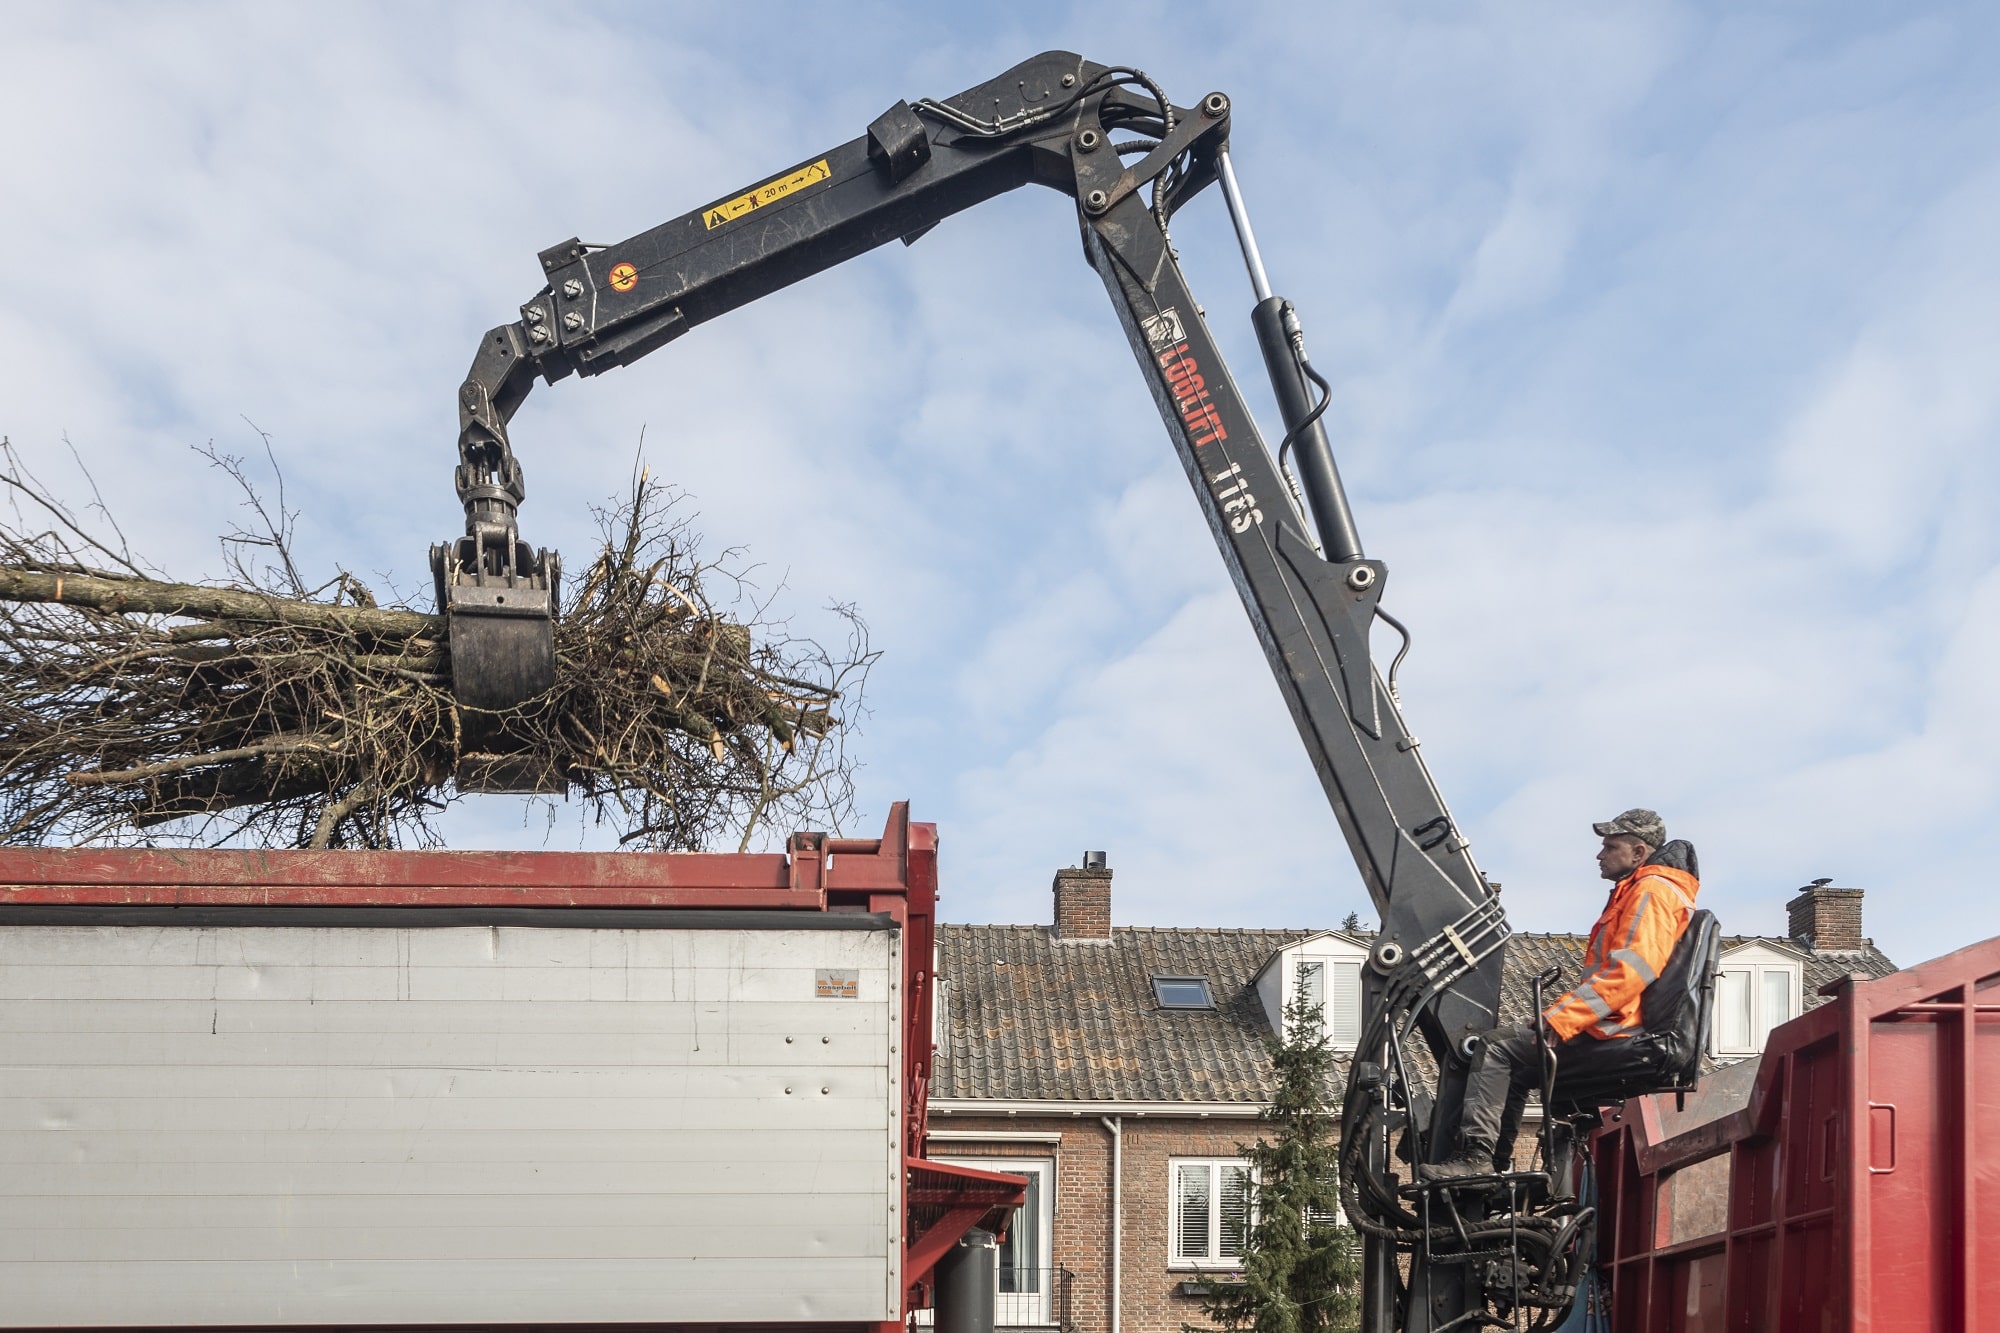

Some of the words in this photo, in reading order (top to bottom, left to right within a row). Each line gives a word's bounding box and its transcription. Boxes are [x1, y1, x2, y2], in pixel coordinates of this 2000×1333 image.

[765, 188, 776, 198] 20
[778, 184, 788, 192] m
[1158, 343, 1228, 448] LOGLIFT
